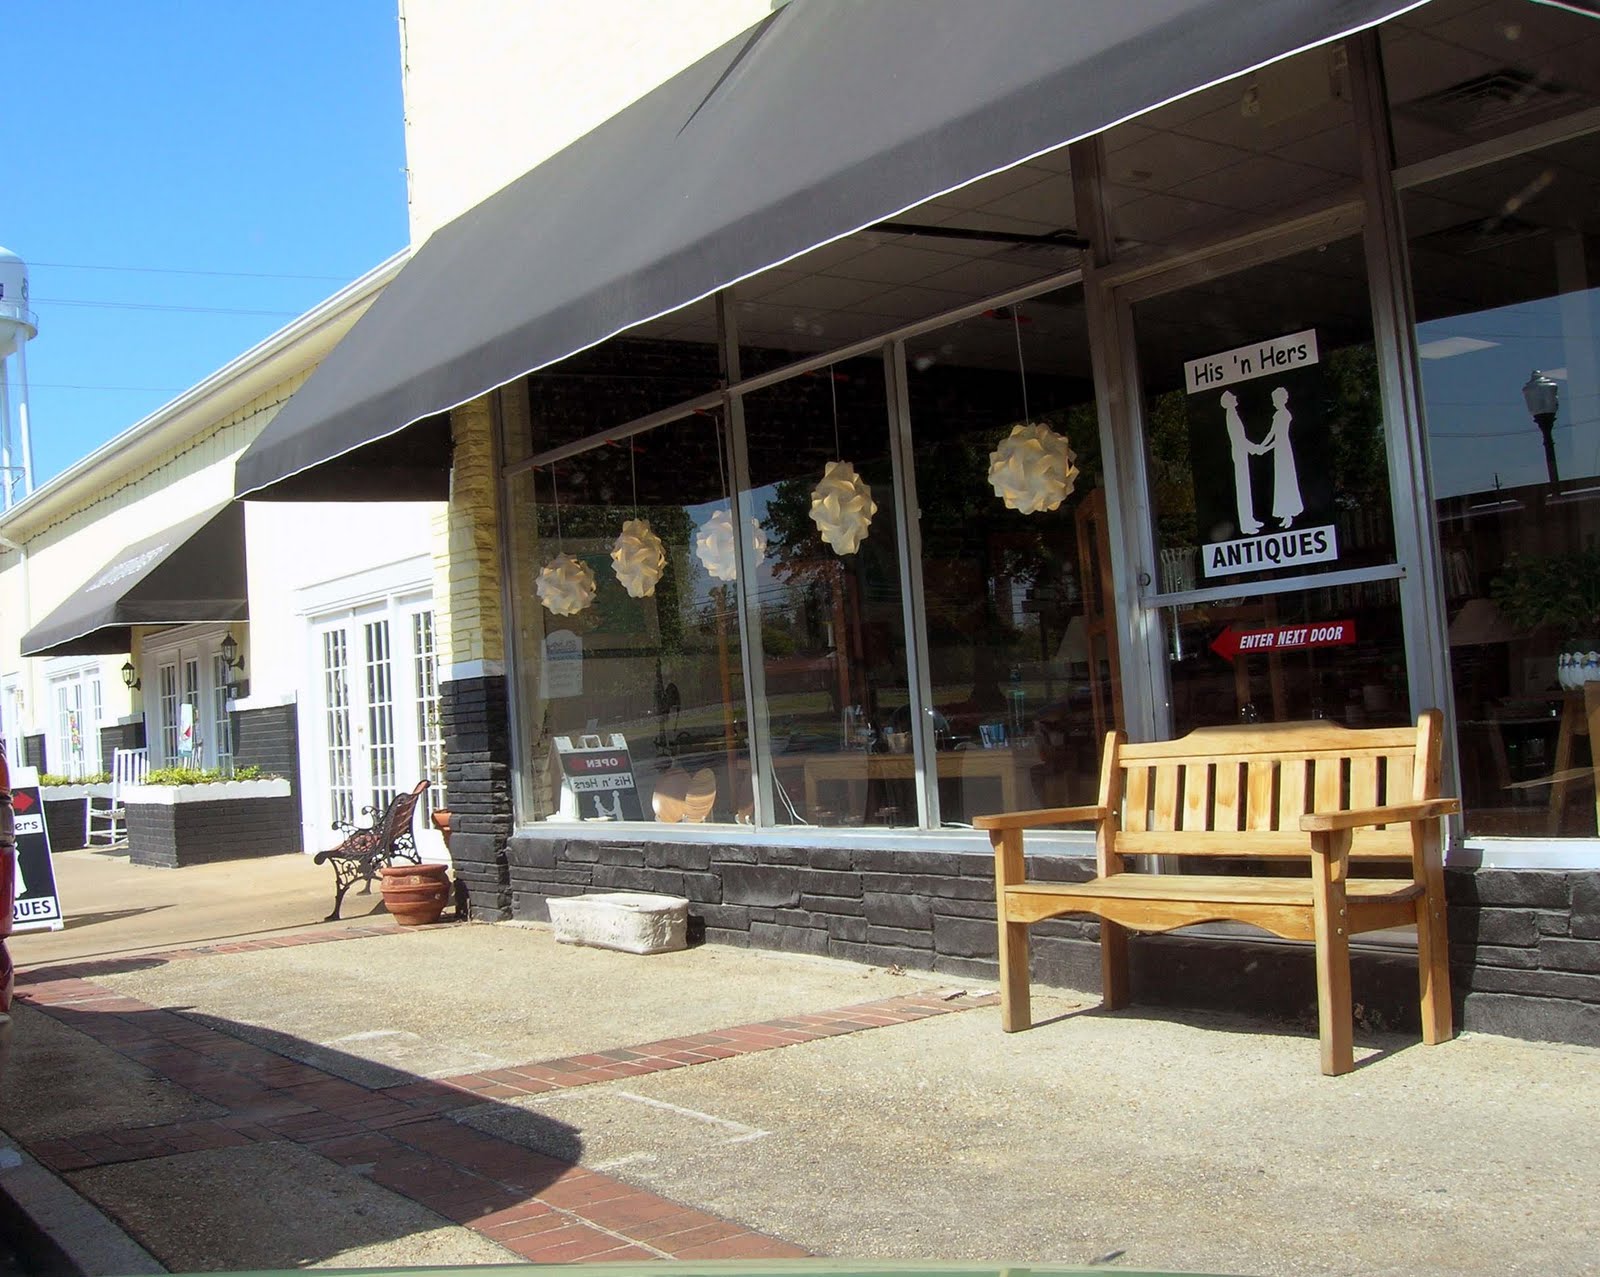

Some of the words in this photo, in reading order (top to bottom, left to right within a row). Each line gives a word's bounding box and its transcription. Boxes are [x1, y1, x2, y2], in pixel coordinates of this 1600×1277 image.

[1195, 362, 1224, 386] His
[1260, 343, 1307, 370] Hers
[1212, 530, 1328, 569] ANTIQUES
[1239, 633, 1274, 649] ENTER
[1275, 629, 1308, 648] NEXT
[1309, 626, 1344, 643] DOOR
[14, 820, 38, 831] ers
